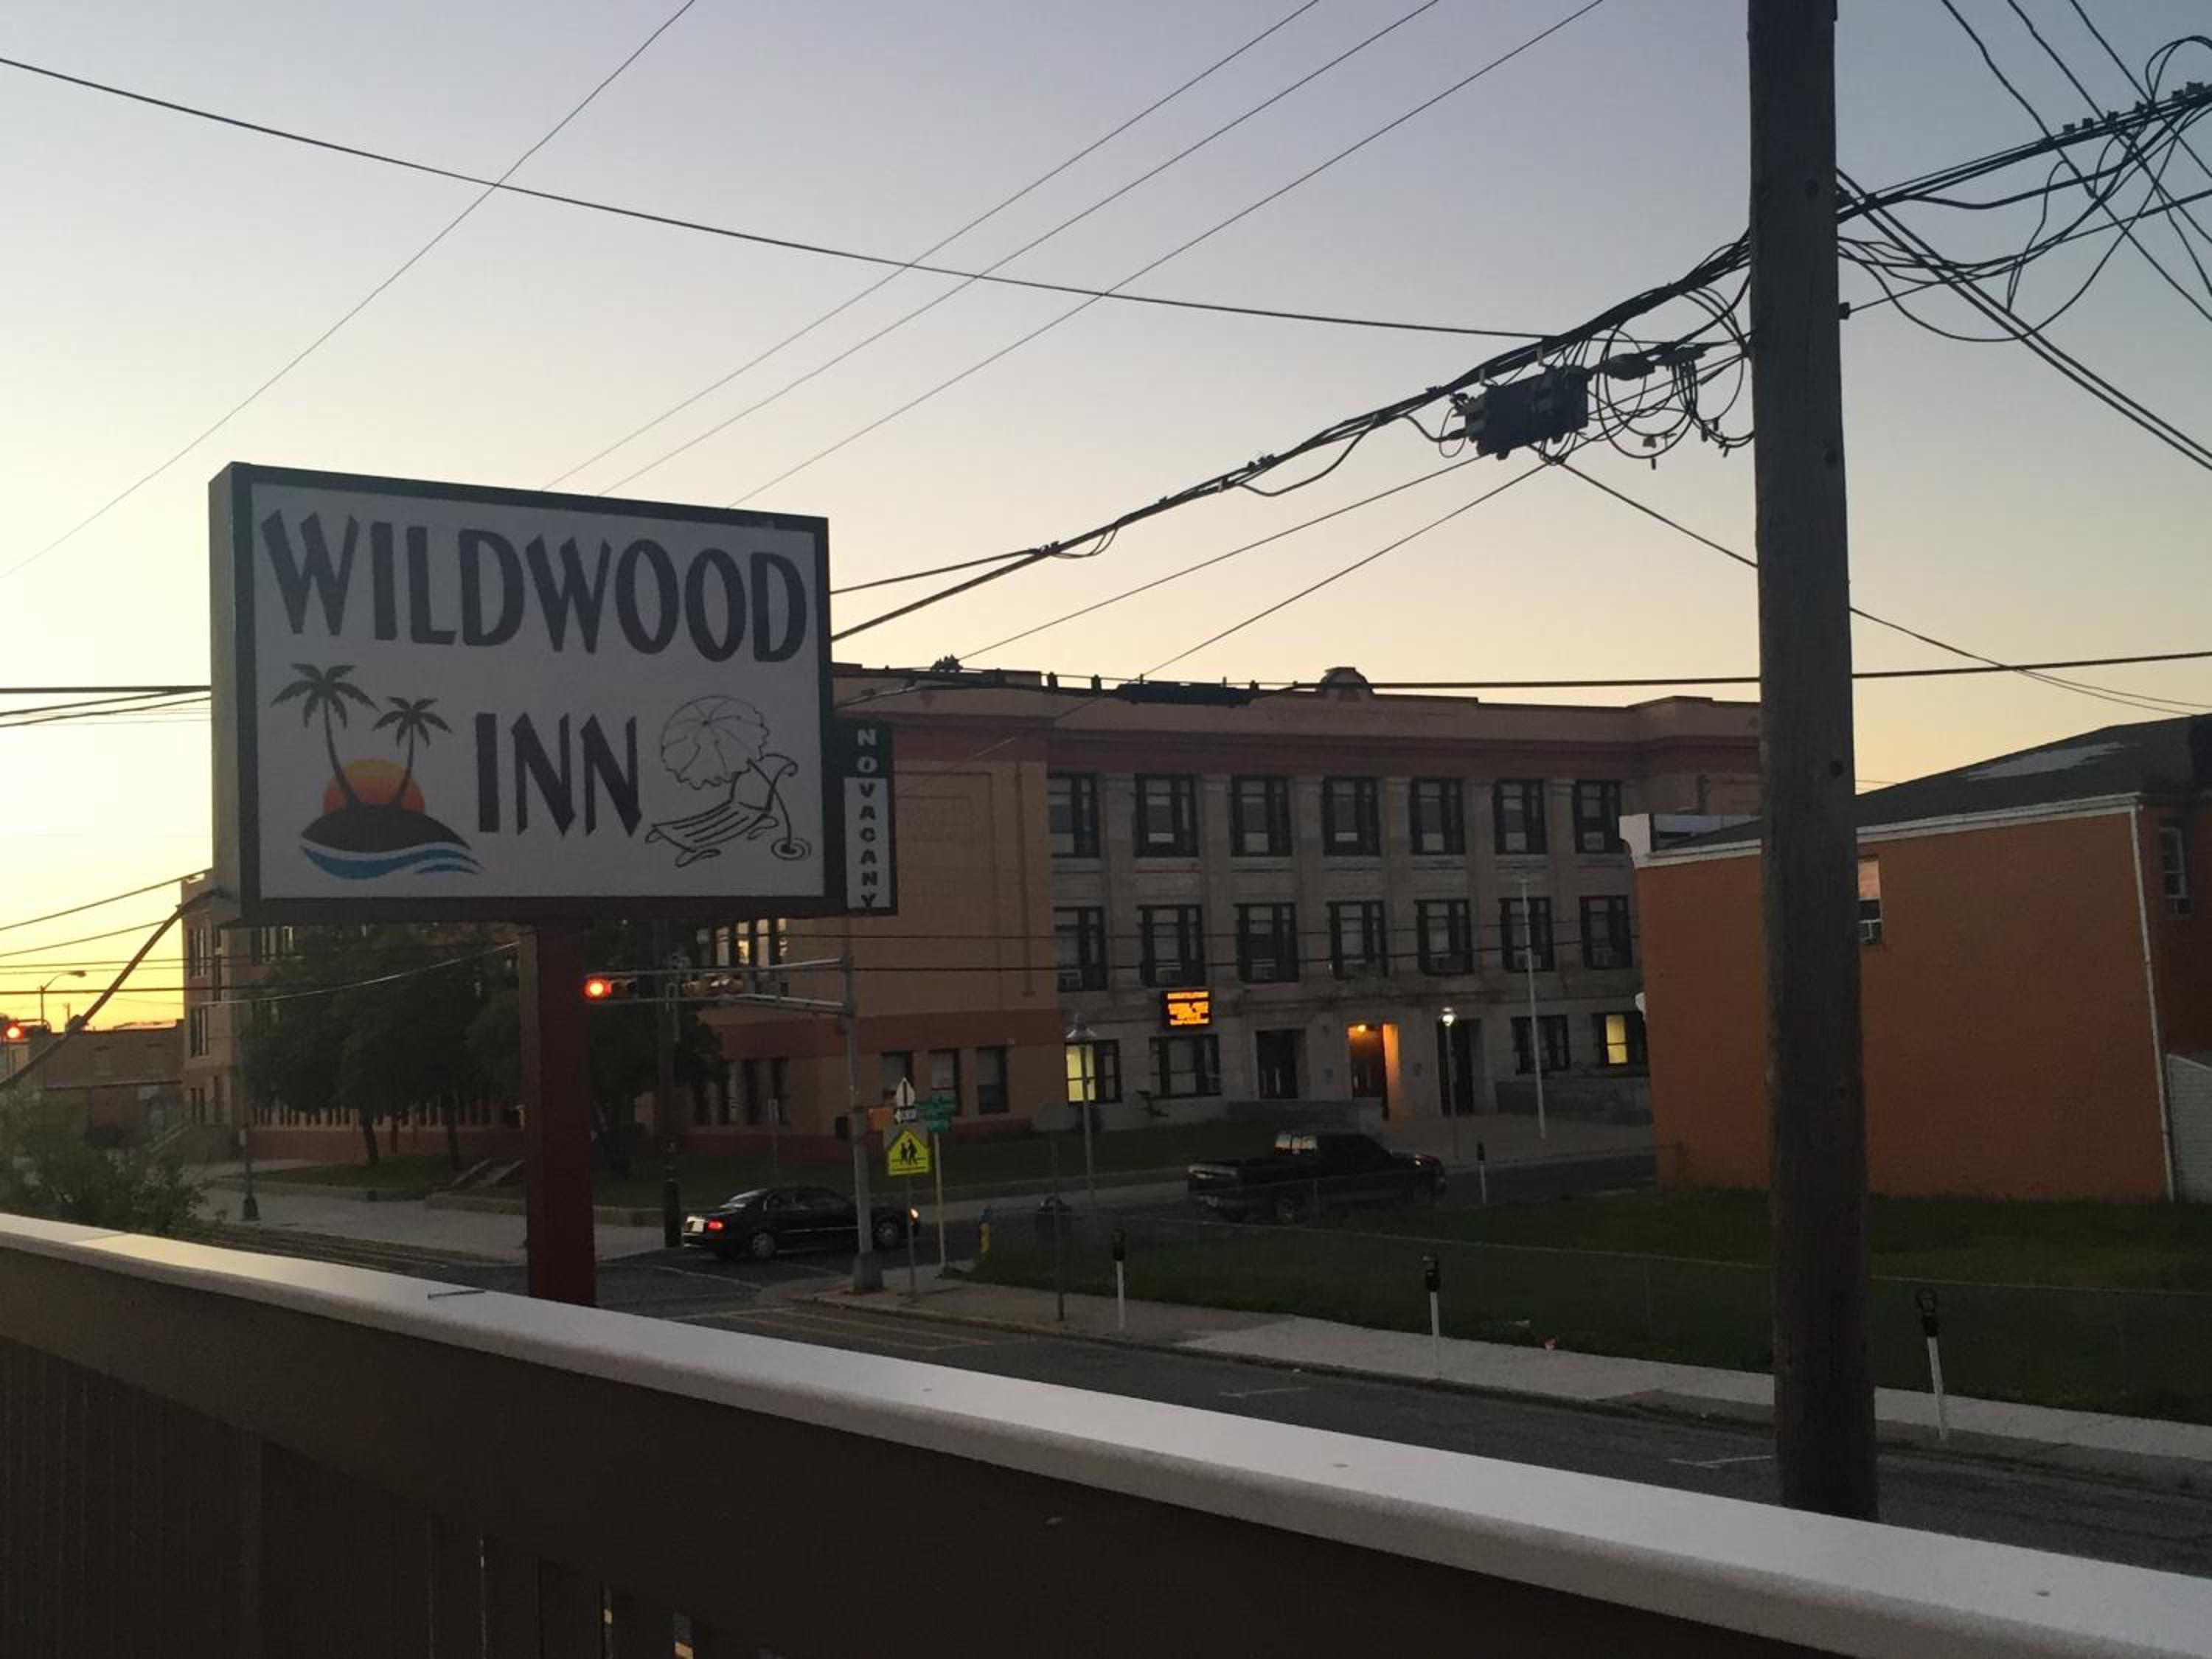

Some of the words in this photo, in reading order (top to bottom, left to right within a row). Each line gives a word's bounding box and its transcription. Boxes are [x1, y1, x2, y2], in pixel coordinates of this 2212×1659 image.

[261, 509, 807, 662] WILDWOOD
[476, 713, 641, 836] INN
[857, 728, 877, 773] NO
